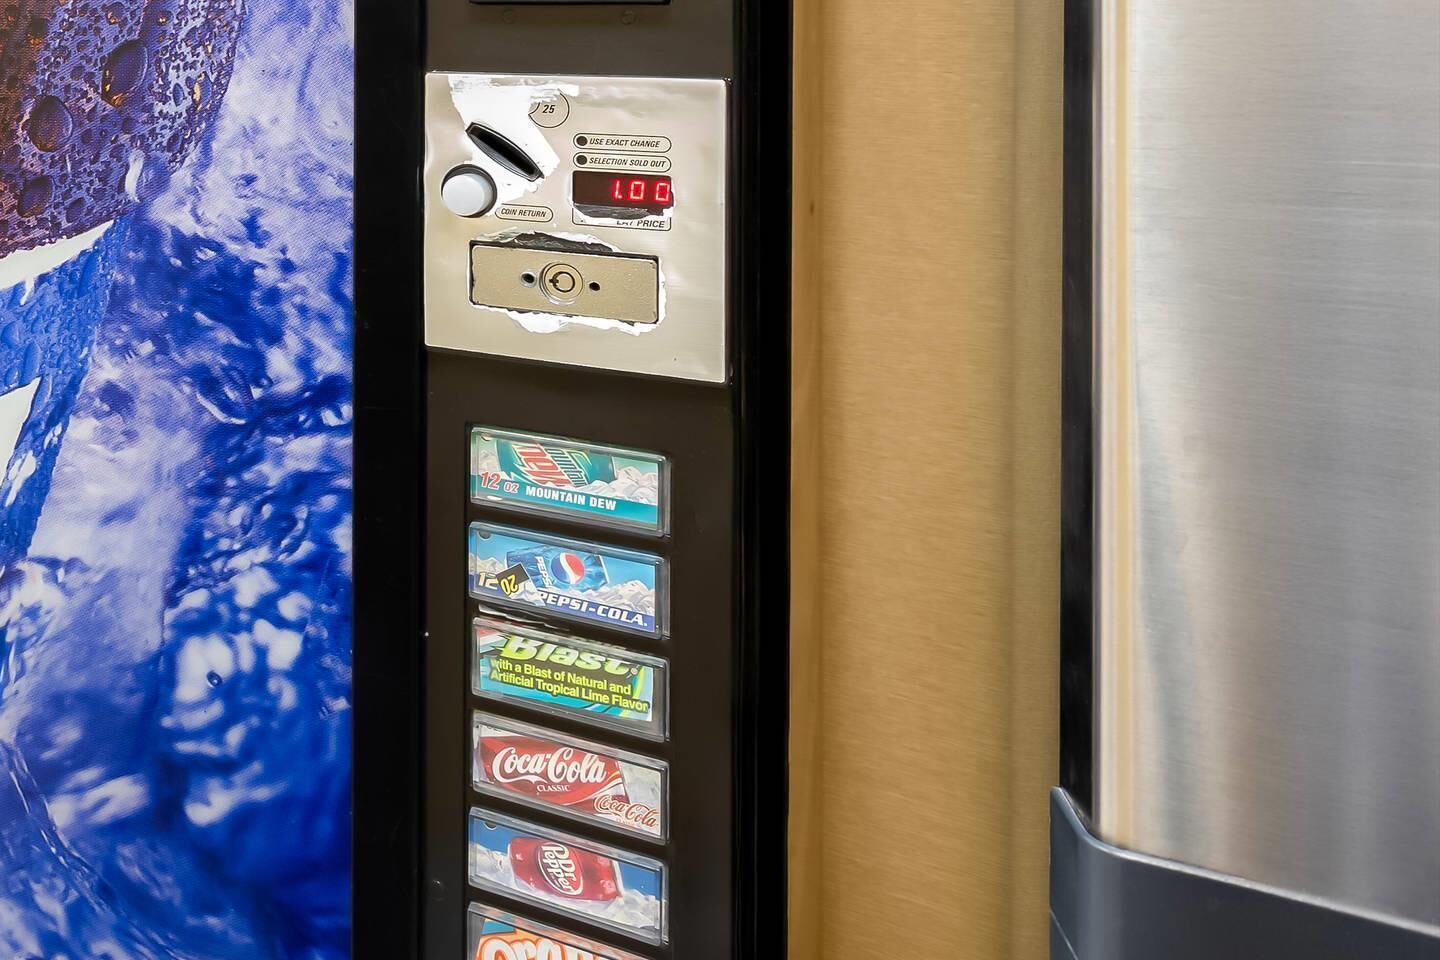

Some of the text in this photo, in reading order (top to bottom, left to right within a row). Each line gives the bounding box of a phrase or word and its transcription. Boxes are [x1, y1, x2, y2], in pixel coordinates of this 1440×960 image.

[542, 104, 555, 114] 25
[589, 137, 661, 148] USE EXACT CHANGE
[589, 156, 667, 168] SELECTION SOLD OUT
[614, 179, 671, 202] 1.00
[500, 208, 547, 218] COIN RETURN
[636, 220, 665, 228] PRICE
[481, 471, 501, 489] 12
[525, 485, 586, 505] MOUNTAIN
[589, 497, 617, 511] DEW
[478, 572, 498, 591] 12
[535, 556, 554, 588] PEPSI
[500, 634, 632, 675] Blast
[490, 658, 632, 695] with a Blast of Natural and
[490, 670, 648, 711] Artificial Tropical Lime Flavor
[492, 747, 607, 784] Coca-Cola
[536, 783, 571, 793] CLASSIC
[541, 845, 575, 893] Pepper
[558, 859, 577, 882] Dr
